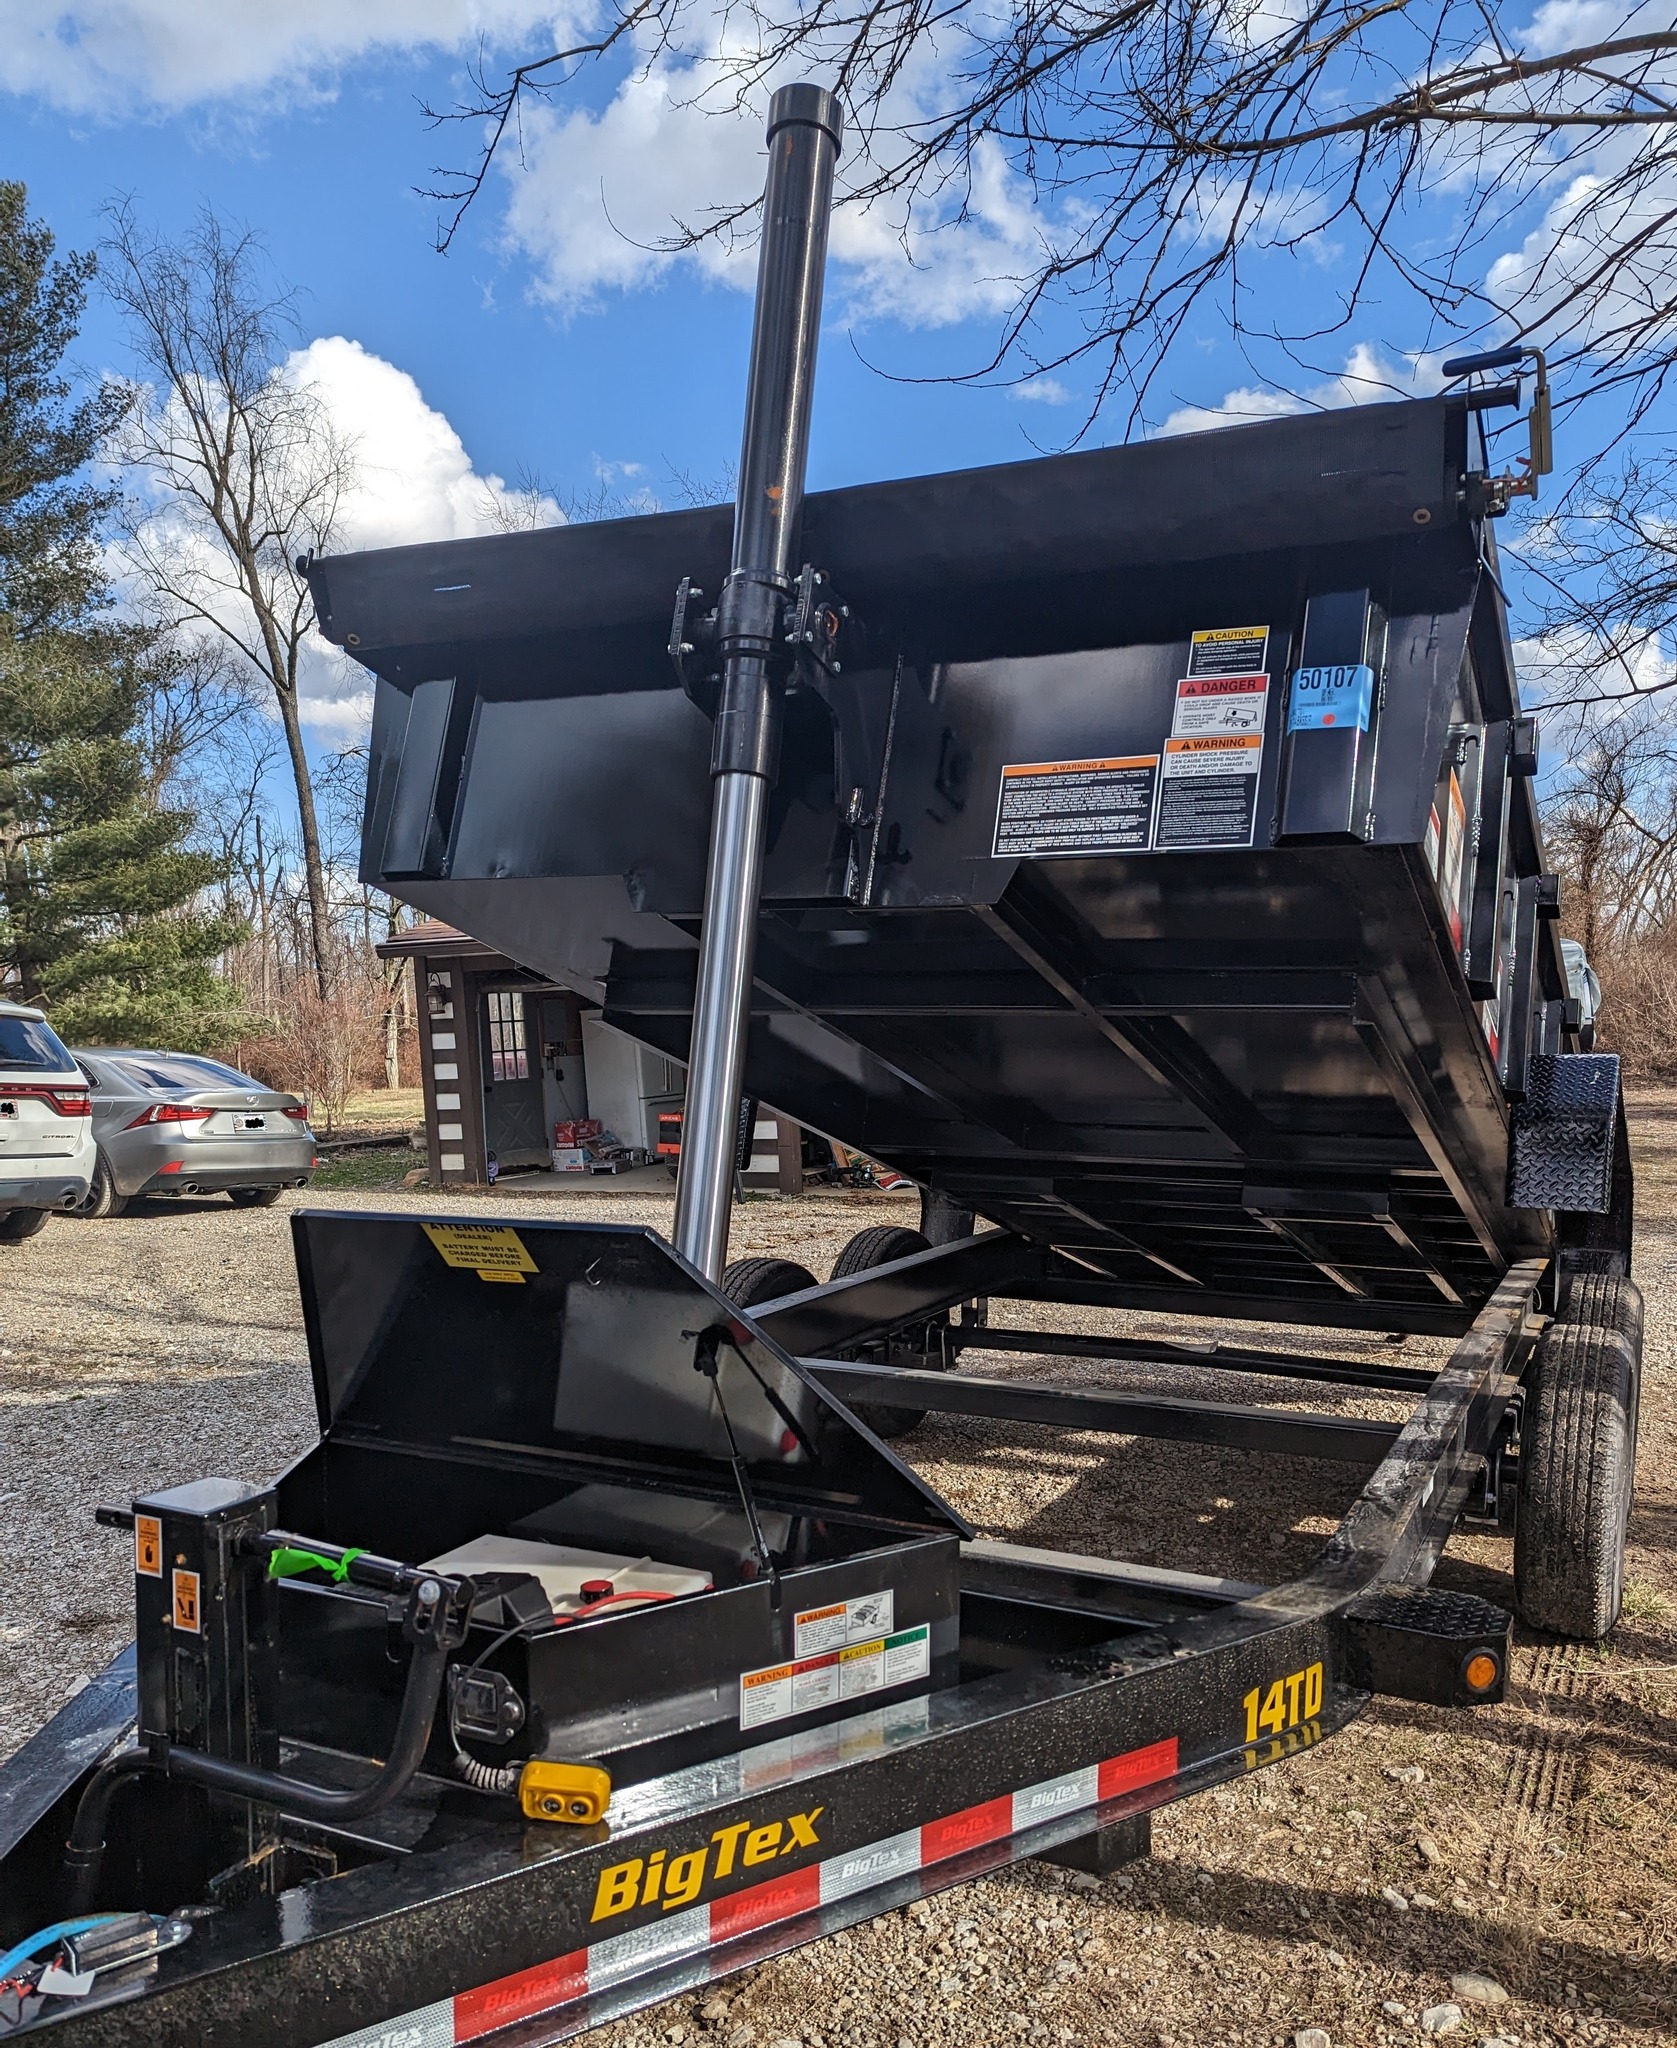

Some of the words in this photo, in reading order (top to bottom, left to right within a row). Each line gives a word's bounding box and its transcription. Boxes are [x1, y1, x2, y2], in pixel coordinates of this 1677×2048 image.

[1215, 630, 1254, 639] CAUTION
[1299, 666, 1358, 690] 50107
[1201, 679, 1256, 693] DANGER
[1193, 738, 1246, 749] WARNING
[1059, 762, 1098, 771] WARNING
[430, 1224, 505, 1234] ATTENTION
[454, 1233, 492, 1242] (DEALER)
[442, 1243, 479, 1251] BATTERY
[448, 1250, 487, 1258] CHARGED
[489, 1252, 522, 1260] BEFORE
[482, 1258, 522, 1266] DELIVERY
[806, 1607, 841, 1621] WARNING
[892, 1632, 919, 1645] NOTICE
[849, 1644, 881, 1658] CAUTION
[805, 1656, 835, 1670] DANGER
[747, 1668, 788, 1685] WARNING
[1243, 1661, 1323, 1743] 14TD
[1030, 1781, 1081, 1808] BigTex
[941, 1814, 994, 1841] BigTex
[590, 1806, 825, 1923] BigTex
[841, 1848, 899, 1880] BigTex
[734, 1886, 798, 1915] BigTex
[483, 1976, 558, 2012] BigTex
